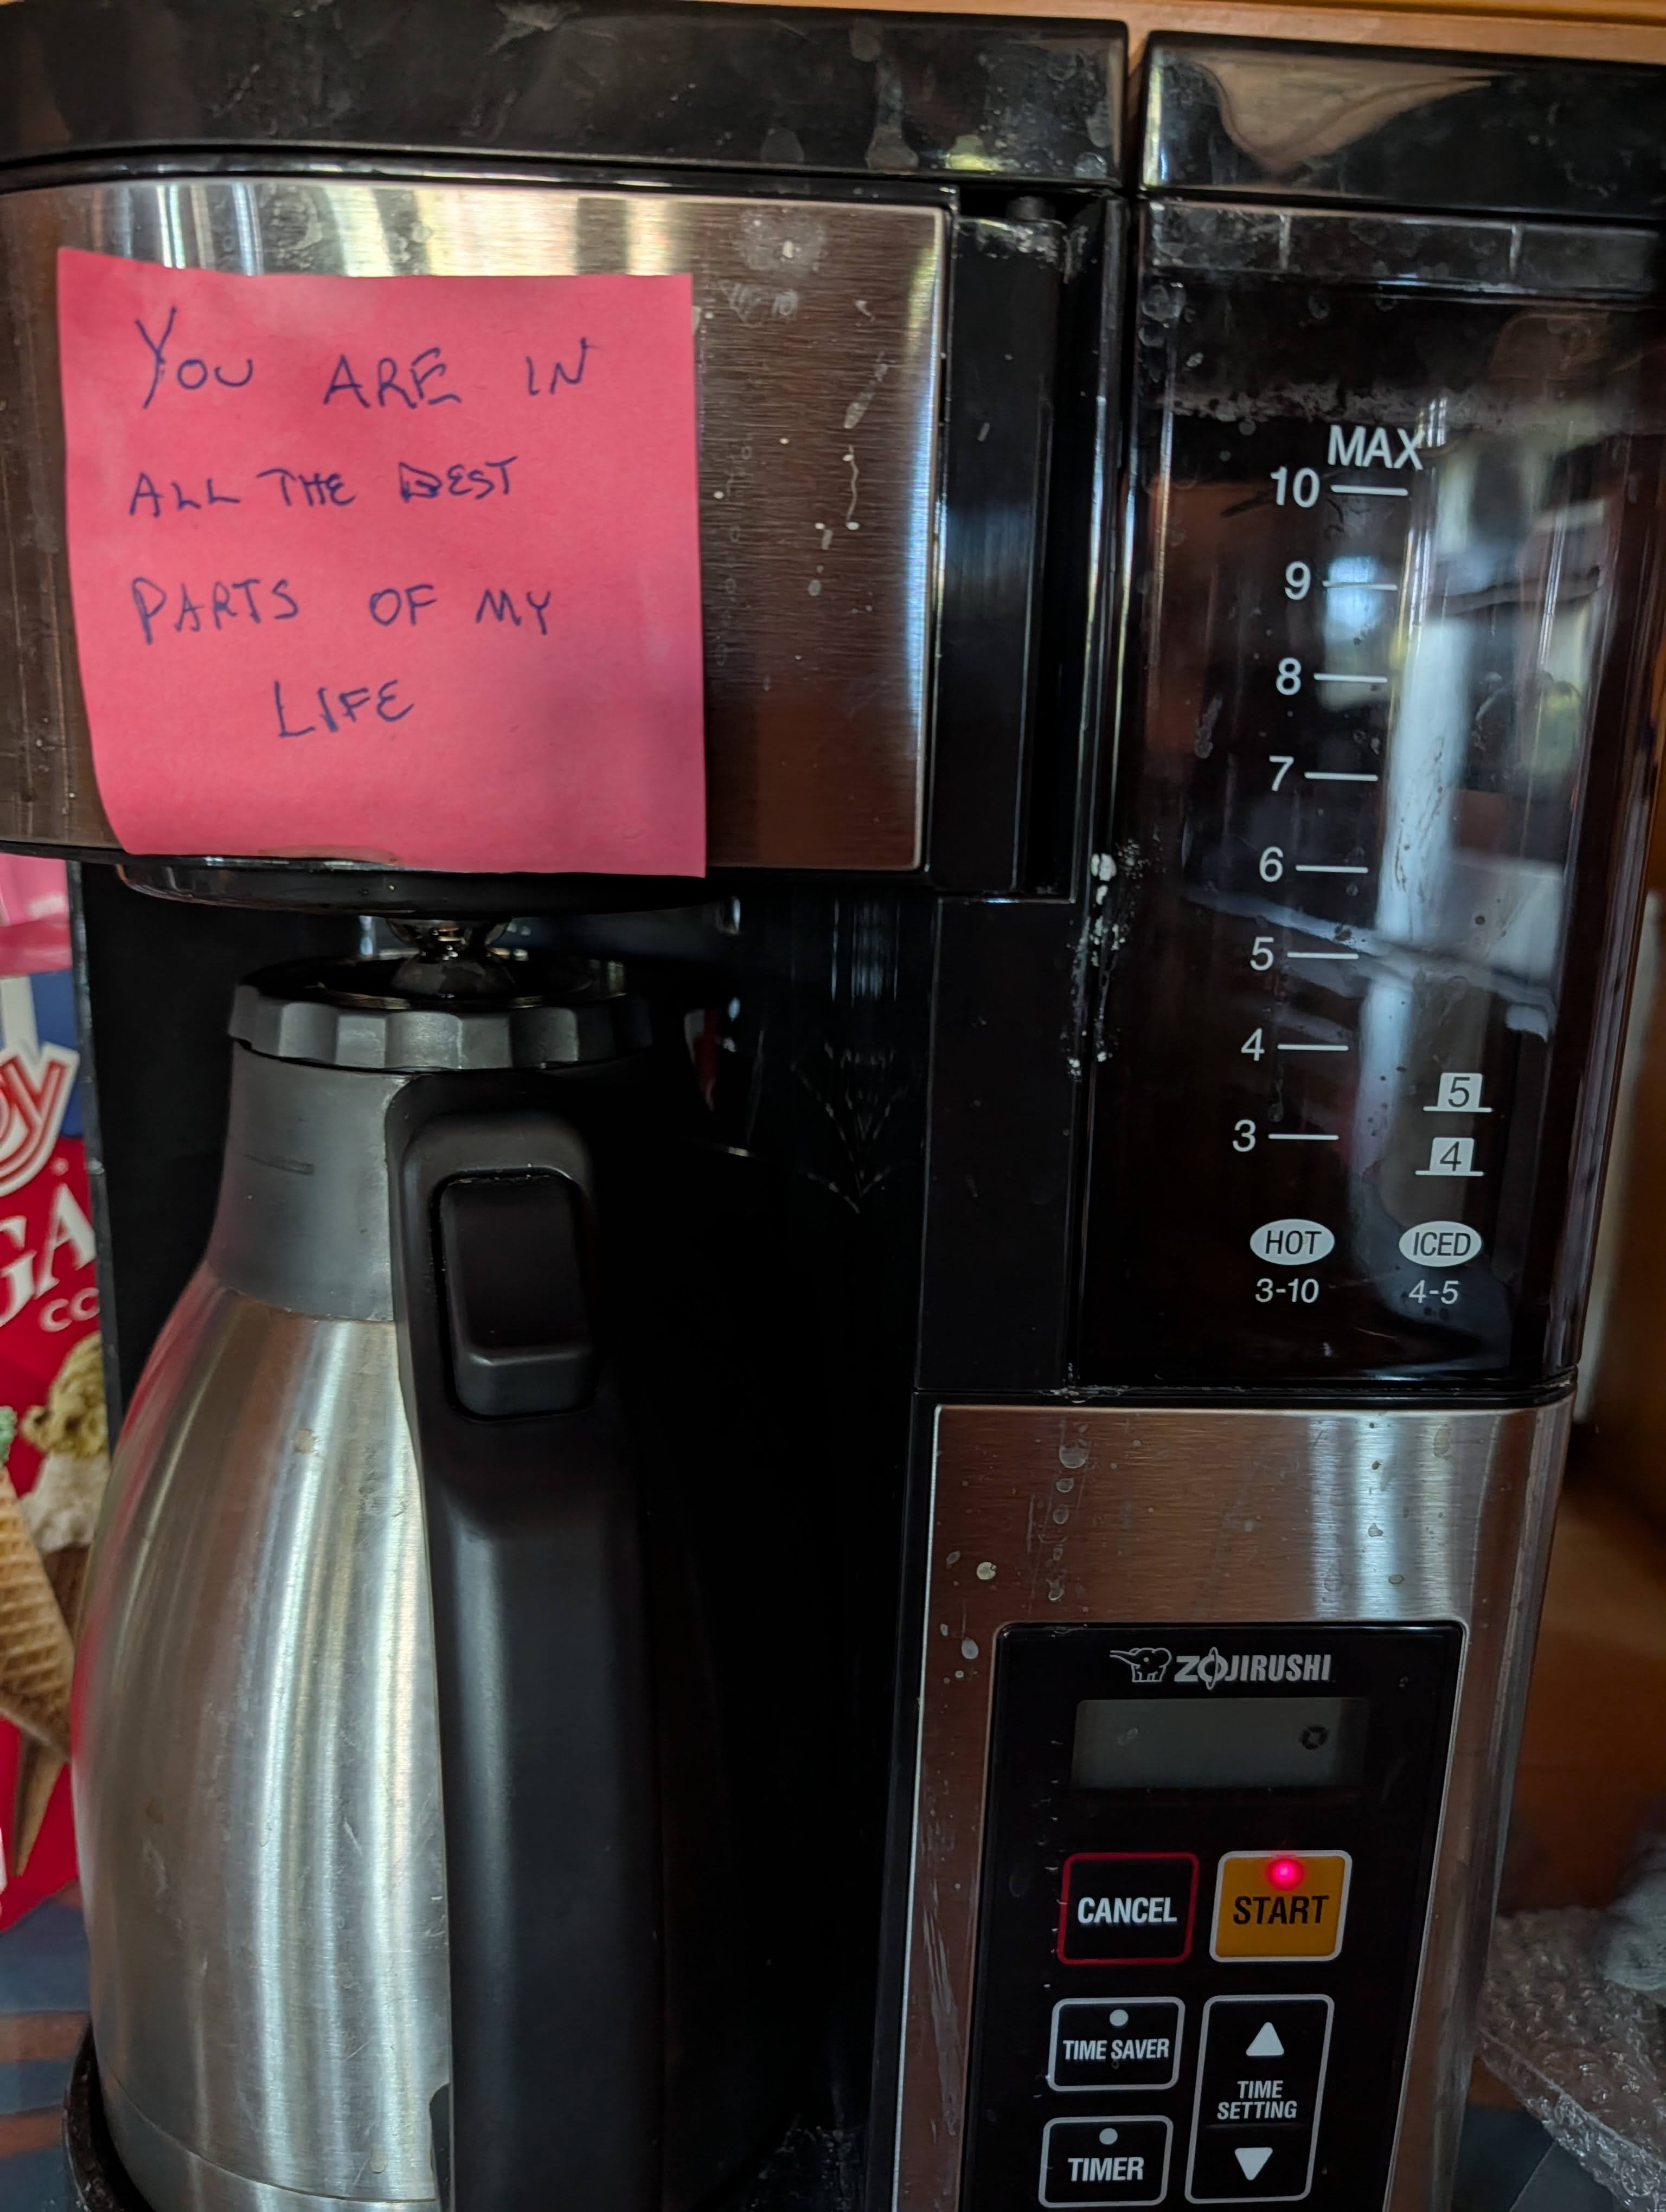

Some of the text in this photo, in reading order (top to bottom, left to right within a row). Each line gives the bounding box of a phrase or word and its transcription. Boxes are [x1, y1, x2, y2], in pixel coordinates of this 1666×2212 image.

[323, 346, 462, 410] ARE
[526, 337, 598, 396] IN
[1328, 424, 1426, 470] MAX
[129, 472, 241, 517] ALL
[257, 467, 355, 506] THE
[1270, 466, 1320, 508] 10
[1285, 561, 1311, 601] 9
[131, 576, 551, 645] PARTS OF MY
[1276, 657, 1302, 696] 8
[273, 679, 415, 738] LIFE
[1268, 755, 1295, 792] 7
[1259, 846, 1284, 883] 6
[1250, 936, 1274, 972] 5
[1240, 1027, 1265, 1062] 4
[1447, 1076, 1471, 1108] 5
[1232, 1118, 1257, 1153] 3
[1439, 1141, 1463, 1172] 4
[1264, 1230, 1322, 1255] HOT
[1412, 1231, 1472, 1257] ICED
[1254, 1277, 1319, 1304] 3-10
[1408, 1279, 1460, 1305] 4-5
[1174, 1647, 1332, 1690] ZOJIRUSHI
[1077, 1896, 1177, 1925] CANCEL
[1232, 1894, 1330, 1925] START
[1062, 2038, 1170, 2060] TIME SAVER
[1236, 2080, 1284, 2099] TIME
[1216, 2100, 1298, 2120] SETTING
[1067, 2156, 1145, 2182] TIMER
